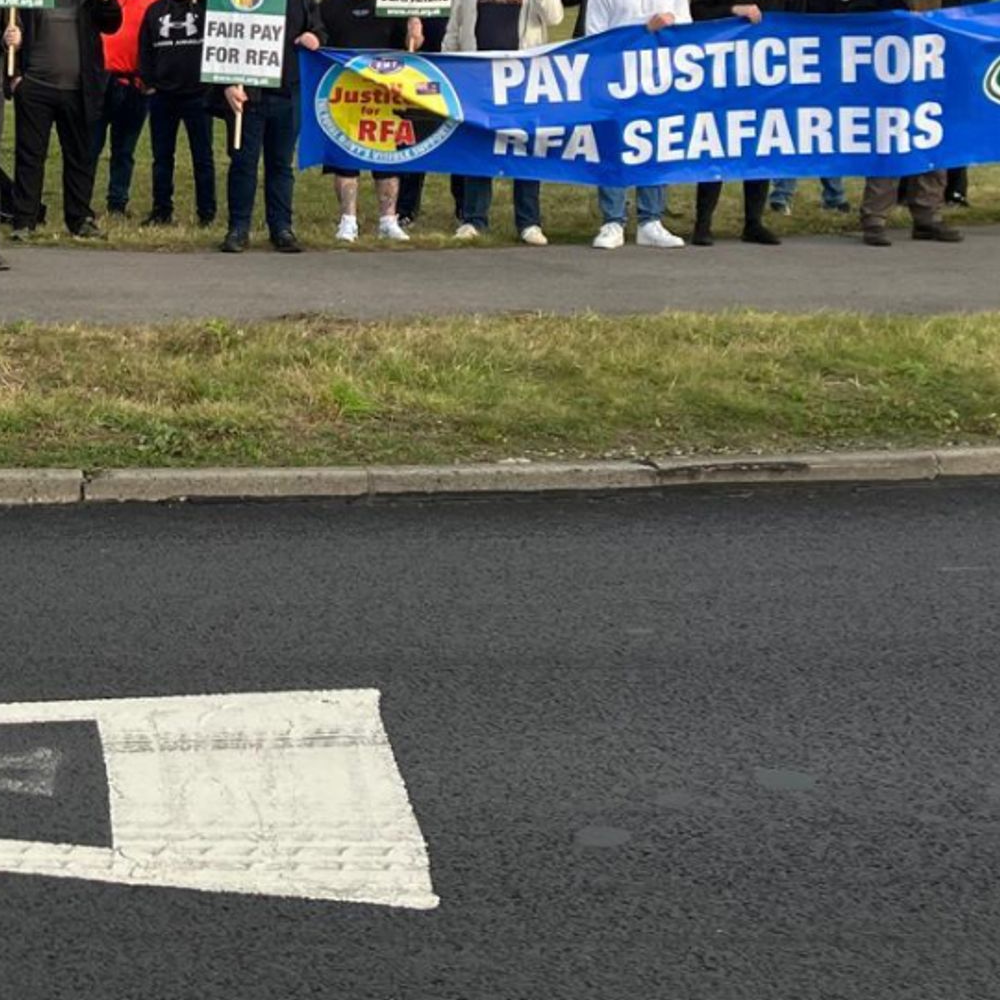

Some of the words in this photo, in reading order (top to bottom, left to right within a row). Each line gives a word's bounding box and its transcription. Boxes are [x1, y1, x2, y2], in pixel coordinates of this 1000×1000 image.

[207, 21, 245, 39] FAIR
[250, 23, 282, 41] PAY
[205, 46, 240, 64] FOR
[246, 49, 280, 67] RFA
[491, 53, 590, 106] PAY
[607, 36, 822, 100] JUSTICE
[840, 33, 946, 84] FOR
[361, 105, 380, 116] for
[358, 118, 416, 146] RFA
[493, 123, 601, 164] RFA
[620, 101, 944, 166] SEAFARERS
